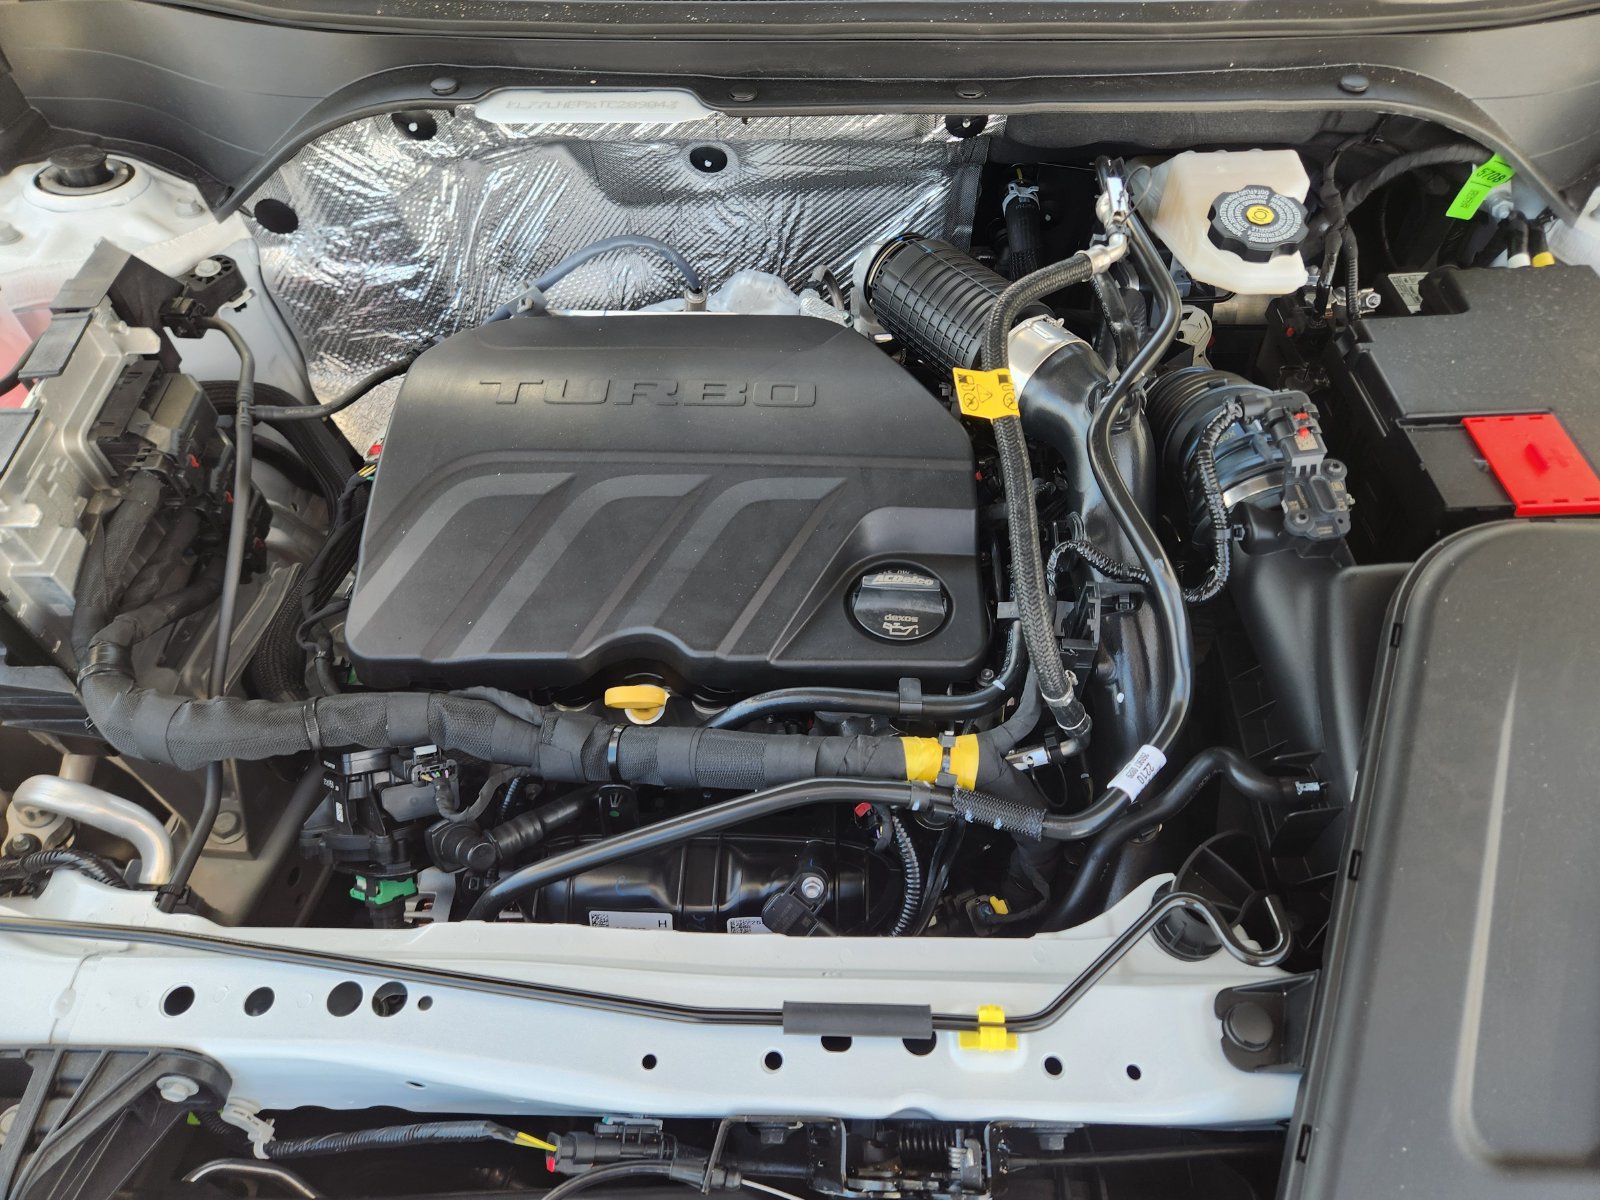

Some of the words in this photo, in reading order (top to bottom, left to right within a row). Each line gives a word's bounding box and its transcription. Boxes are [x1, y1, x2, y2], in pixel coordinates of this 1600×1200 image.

[1476, 167, 1506, 183] 5708
[479, 379, 817, 407] TURBO
[872, 574, 934, 586] ACDelco
[884, 613, 919, 623] dexos
[1136, 762, 1155, 785] 2210
[658, 919, 668, 928] H
